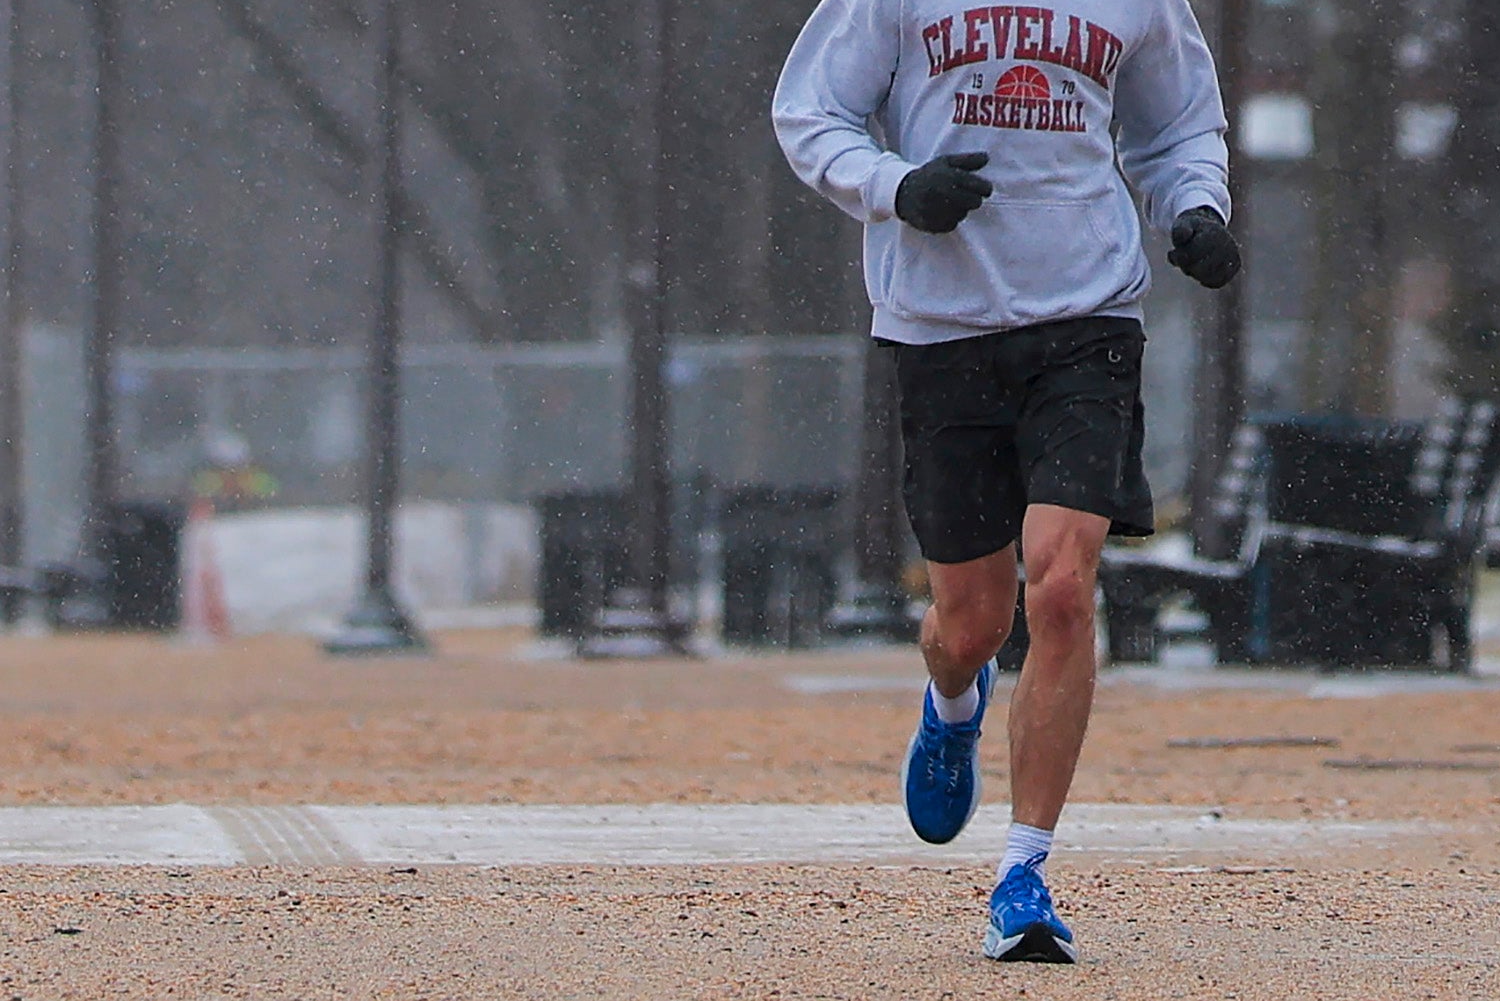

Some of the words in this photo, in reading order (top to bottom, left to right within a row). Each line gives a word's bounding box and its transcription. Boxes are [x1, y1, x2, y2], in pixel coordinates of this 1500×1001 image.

[922, 6, 1123, 90] CLEVELAND
[1061, 80, 1075, 95] 70
[952, 92, 1086, 132] BASKETBALL
